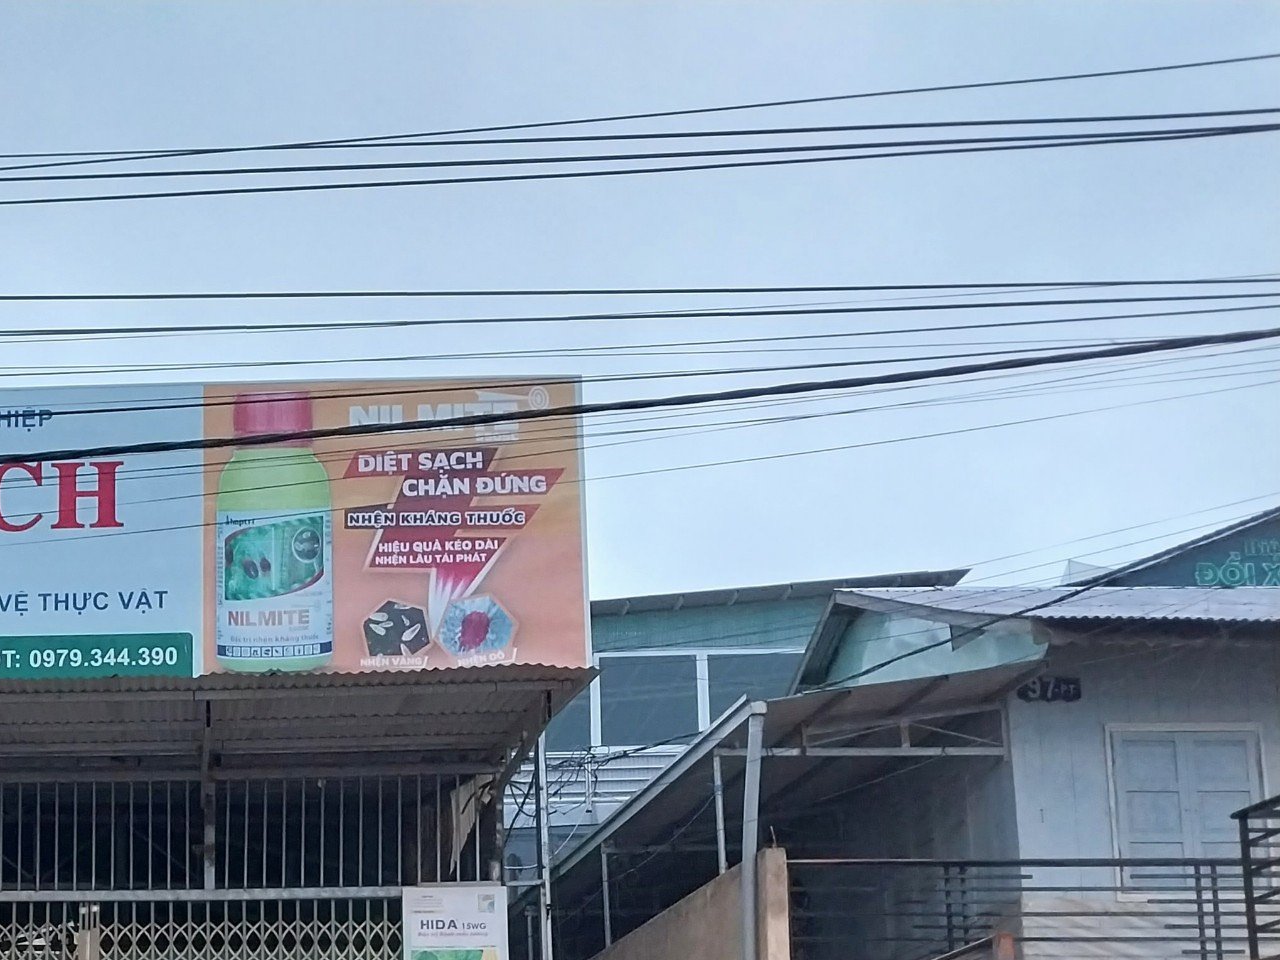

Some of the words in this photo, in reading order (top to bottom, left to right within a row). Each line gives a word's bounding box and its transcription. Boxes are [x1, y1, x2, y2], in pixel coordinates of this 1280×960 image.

[358, 451, 412, 475] DIỆT
[418, 451, 483, 474] SẠCH
[402, 474, 470, 499] CHẶN
[476, 472, 547, 494] ĐỨNG
[347, 509, 396, 528] NHỆN
[399, 510, 461, 526] KHÁNG
[466, 507, 526, 525] THUỐC
[378, 540, 410, 554] HIỆU
[445, 538, 473, 551] KÉO
[475, 538, 499, 550] DÀI
[375, 554, 407, 566] NHỆN
[409, 553, 433, 564] LÂU
[434, 553, 454, 563] TÁI
[456, 552, 487, 563] PHÁT
[38, 590, 108, 615] THỰC
[119, 588, 168, 614] VẬT
[228, 609, 310, 626] NILMITE
[29, 646, 178, 669] 0979.344.390
[420, 919, 458, 930] HIDA
[462, 922, 487, 930] 15WG
